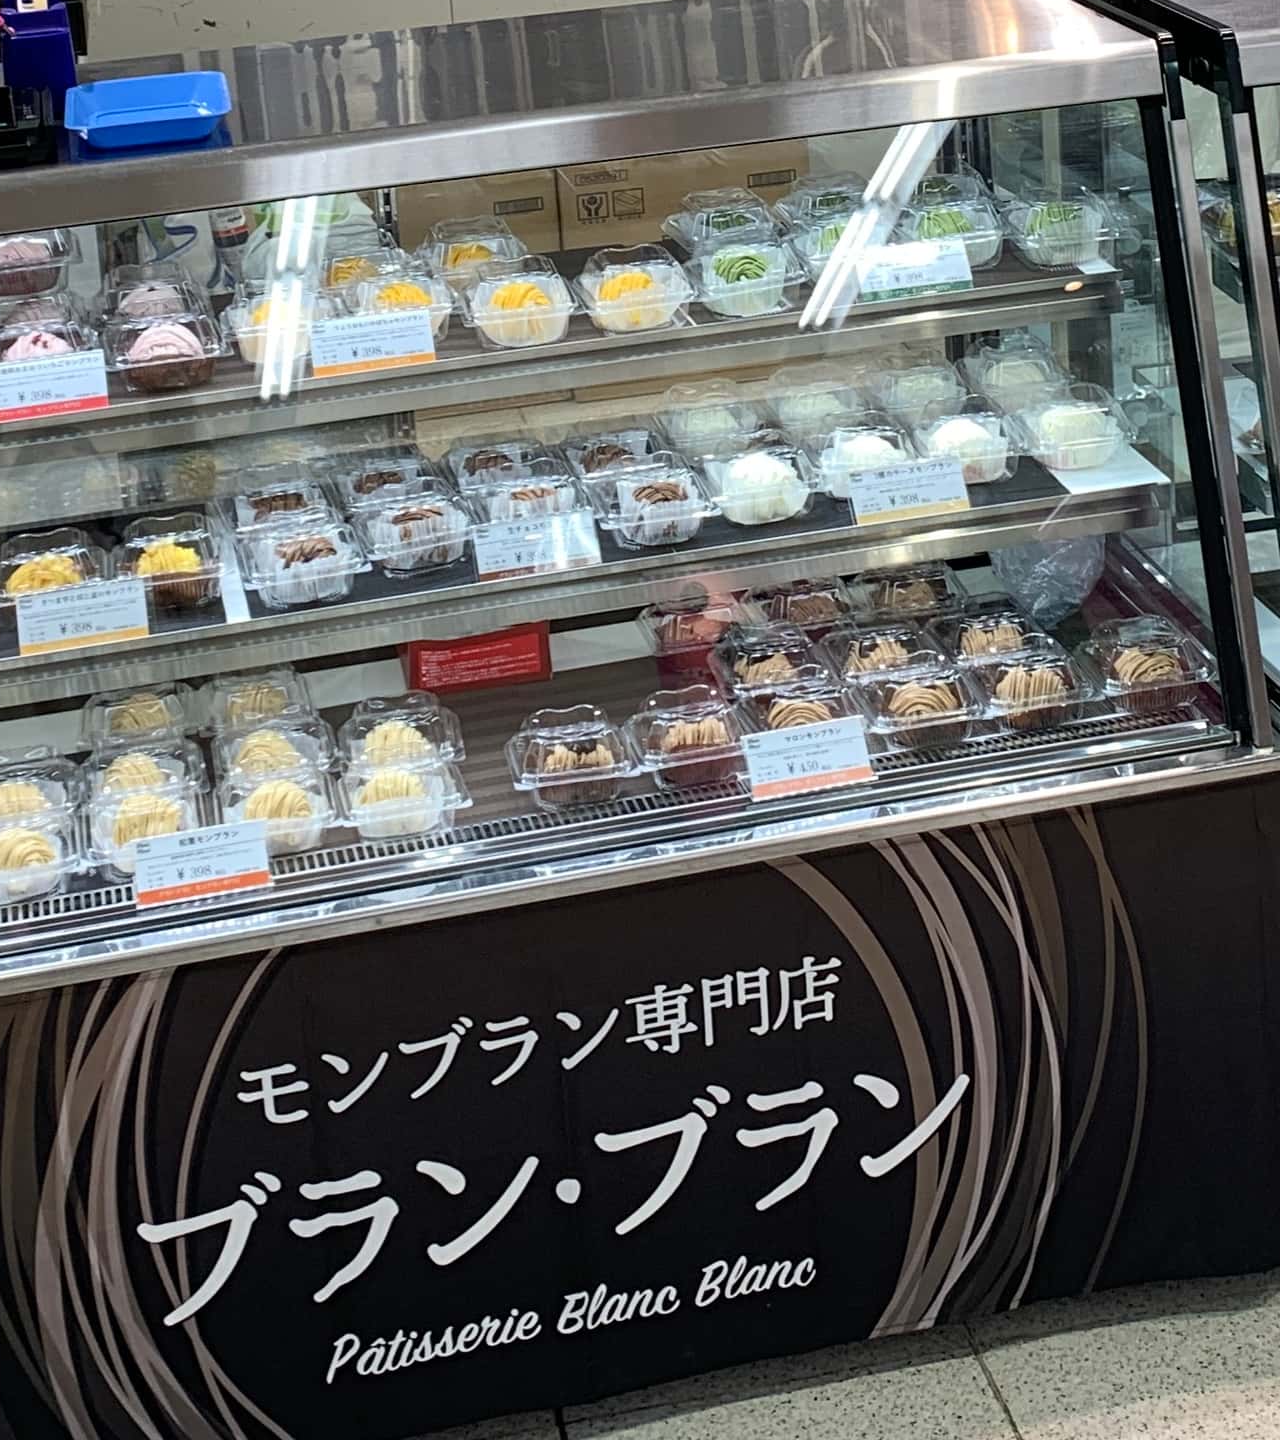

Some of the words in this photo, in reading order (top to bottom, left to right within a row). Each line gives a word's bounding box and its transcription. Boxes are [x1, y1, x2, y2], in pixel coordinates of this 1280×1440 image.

[238, 957, 843, 1125] モンブラン専門店
[138, 1072, 971, 1326] ブラン・ブラン
[326, 1306, 541, 1385] Pâtisserie
[557, 1285, 680, 1338] Blanc
[697, 1254, 817, 1307] Blanc
